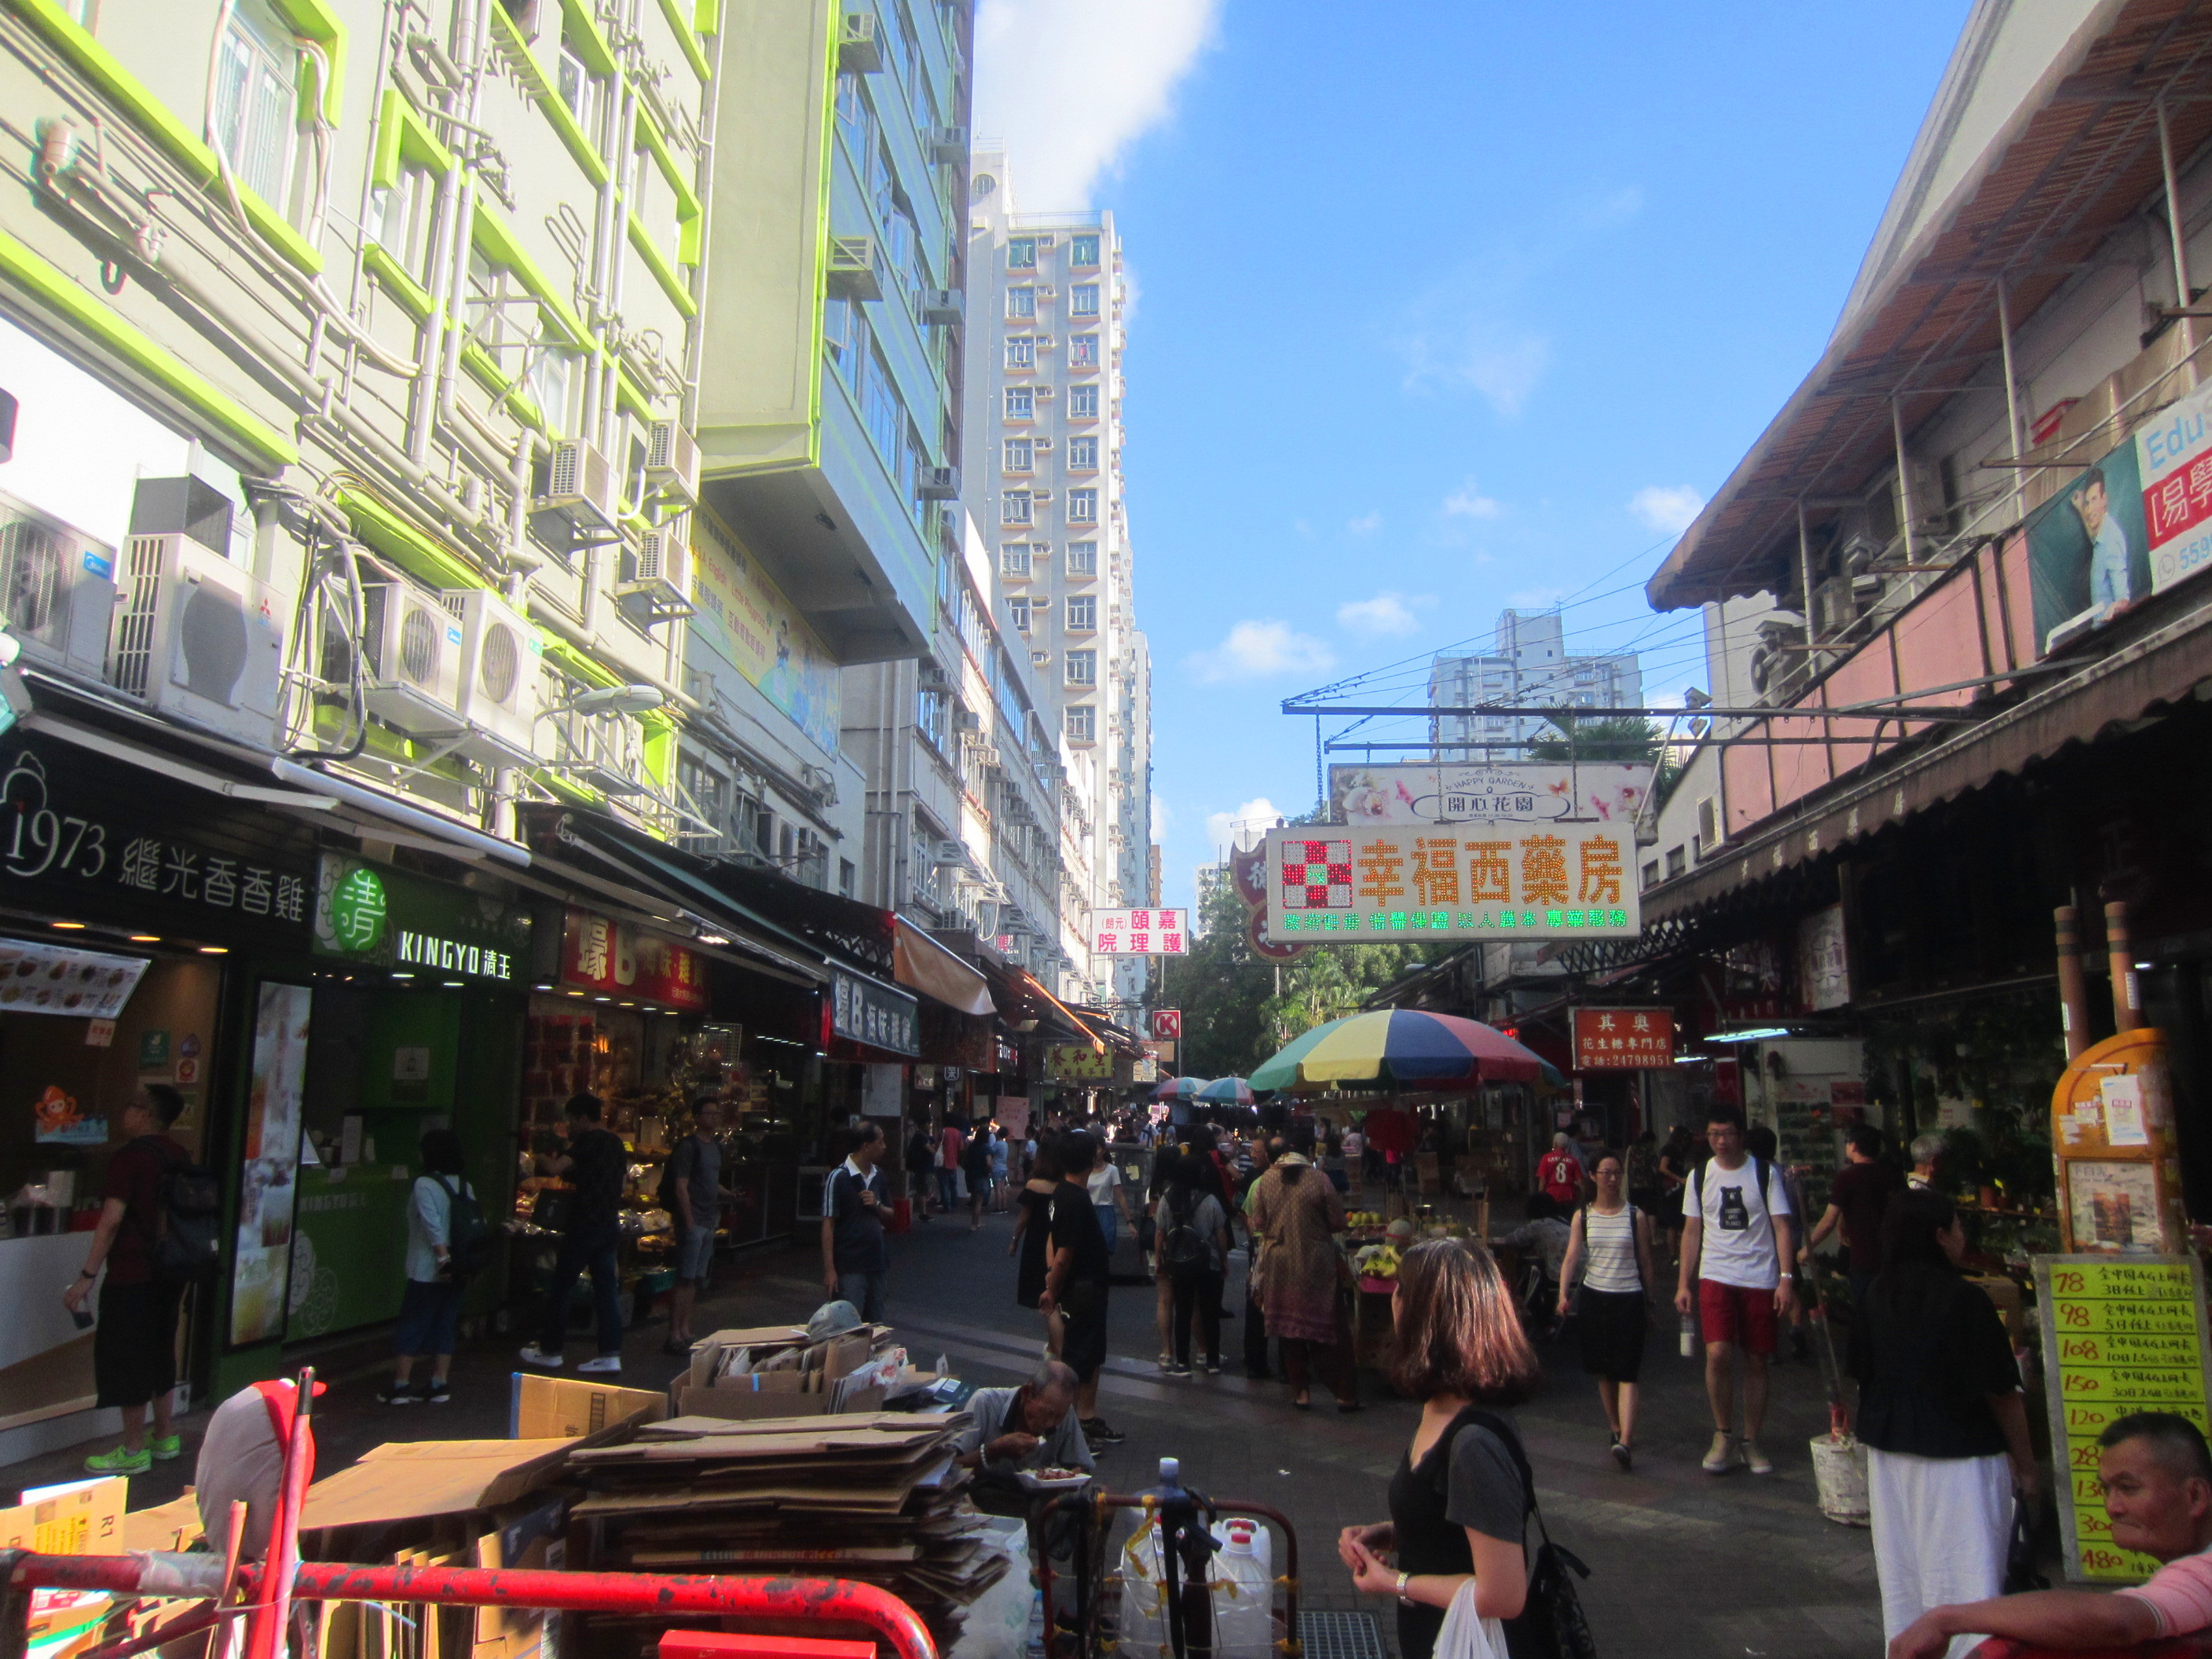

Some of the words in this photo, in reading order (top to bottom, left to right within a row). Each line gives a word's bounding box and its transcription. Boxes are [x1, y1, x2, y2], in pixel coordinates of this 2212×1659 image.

[2180, 533, 2212, 570] 559
[1454, 777, 1484, 789] HAPPY
[1489, 777, 1526, 789] GARDEN
[1448, 797, 1533, 811] 開心花園
[6, 810, 106, 877] 1973
[119, 837, 305, 922] 繼光香香雞
[1358, 834, 1622, 906] 幸福西藥房
[399, 931, 479, 974] KINGYO
[482, 949, 511, 980] 清玉
[1555, 1163, 1566, 1183] 8
[2054, 1273, 2085, 1293] 78
[2060, 1303, 2090, 1327] 98
[2063, 1339, 2099, 1361] 108
[2064, 1374, 2099, 1392] 150
[2070, 1408, 2105, 1426] 120
[2079, 1514, 2113, 1533] 30
[2082, 1549, 2124, 1569] 480
